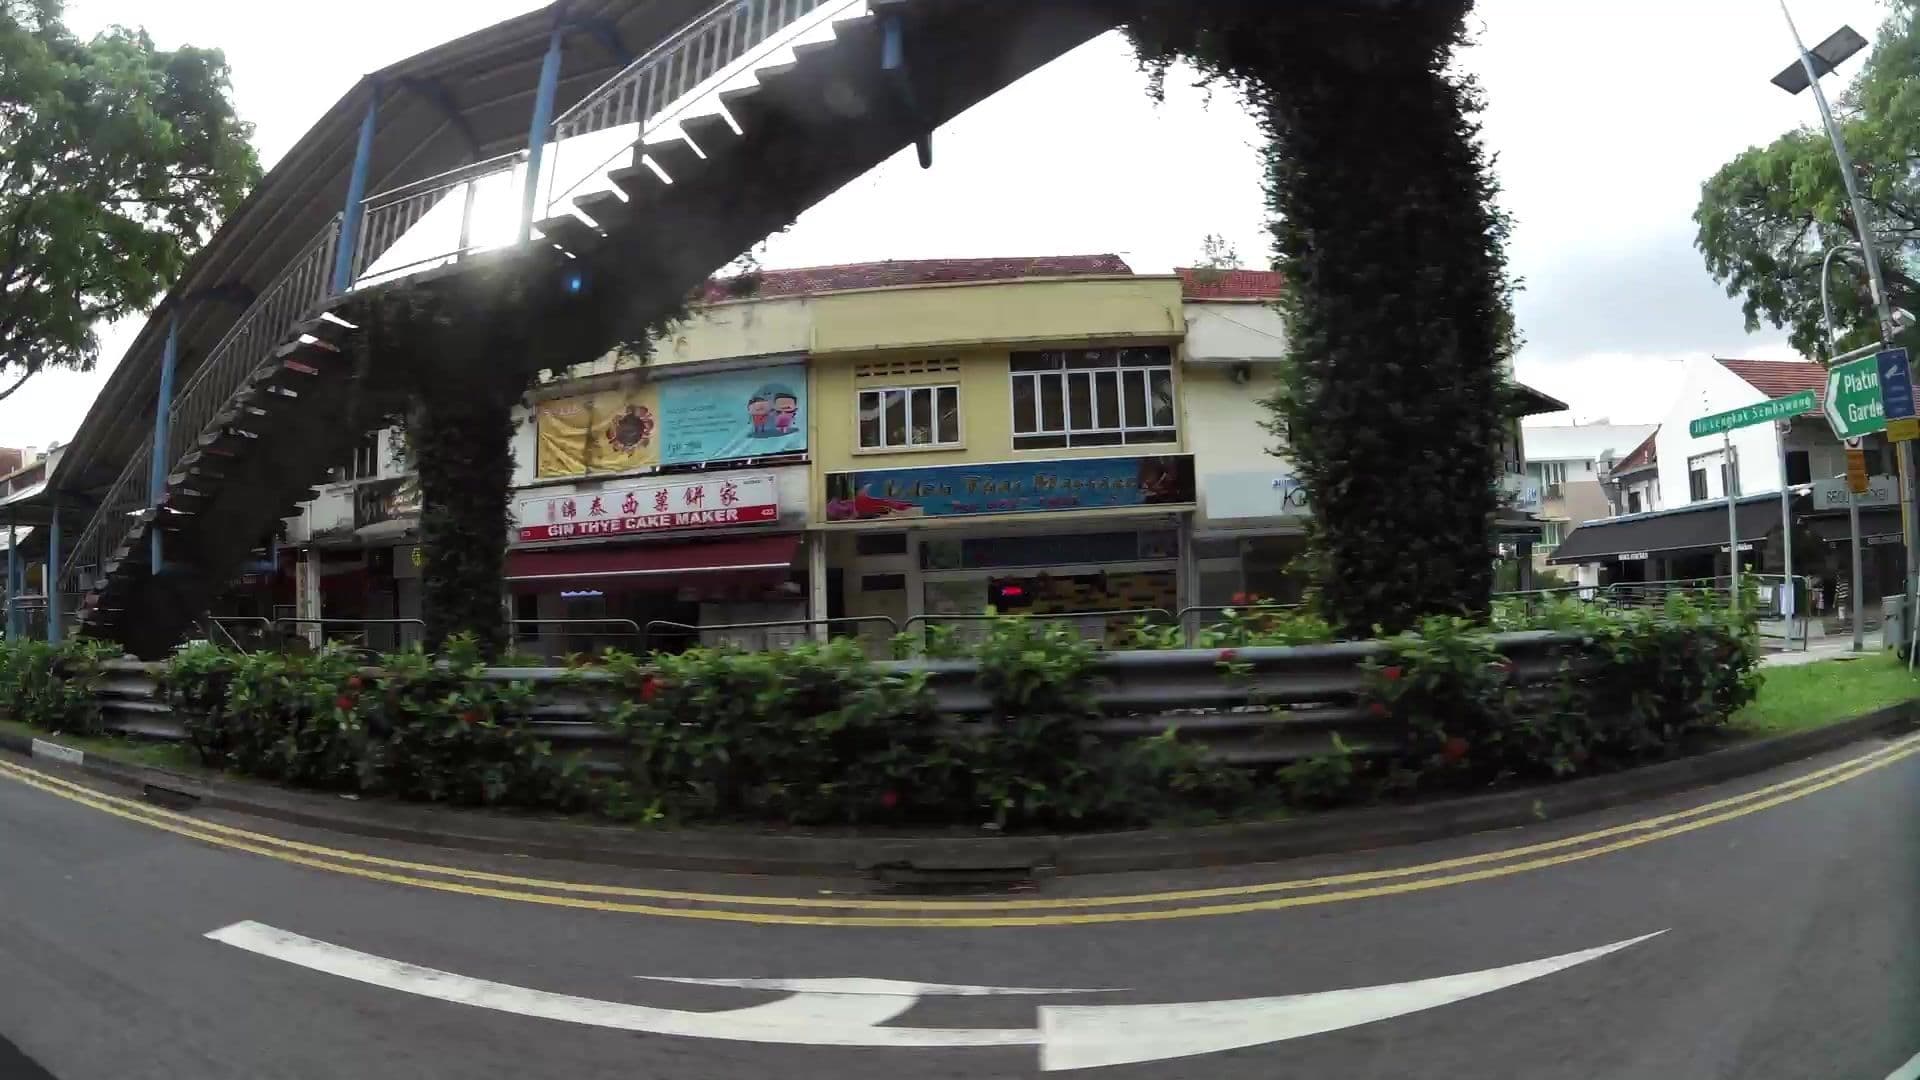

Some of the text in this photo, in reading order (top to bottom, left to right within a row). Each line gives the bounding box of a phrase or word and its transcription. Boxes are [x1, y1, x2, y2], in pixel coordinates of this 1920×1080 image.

[1752, 396, 1811, 419] Sembawang
[548, 508, 739, 537] GIN THYE CAKE MAKER
